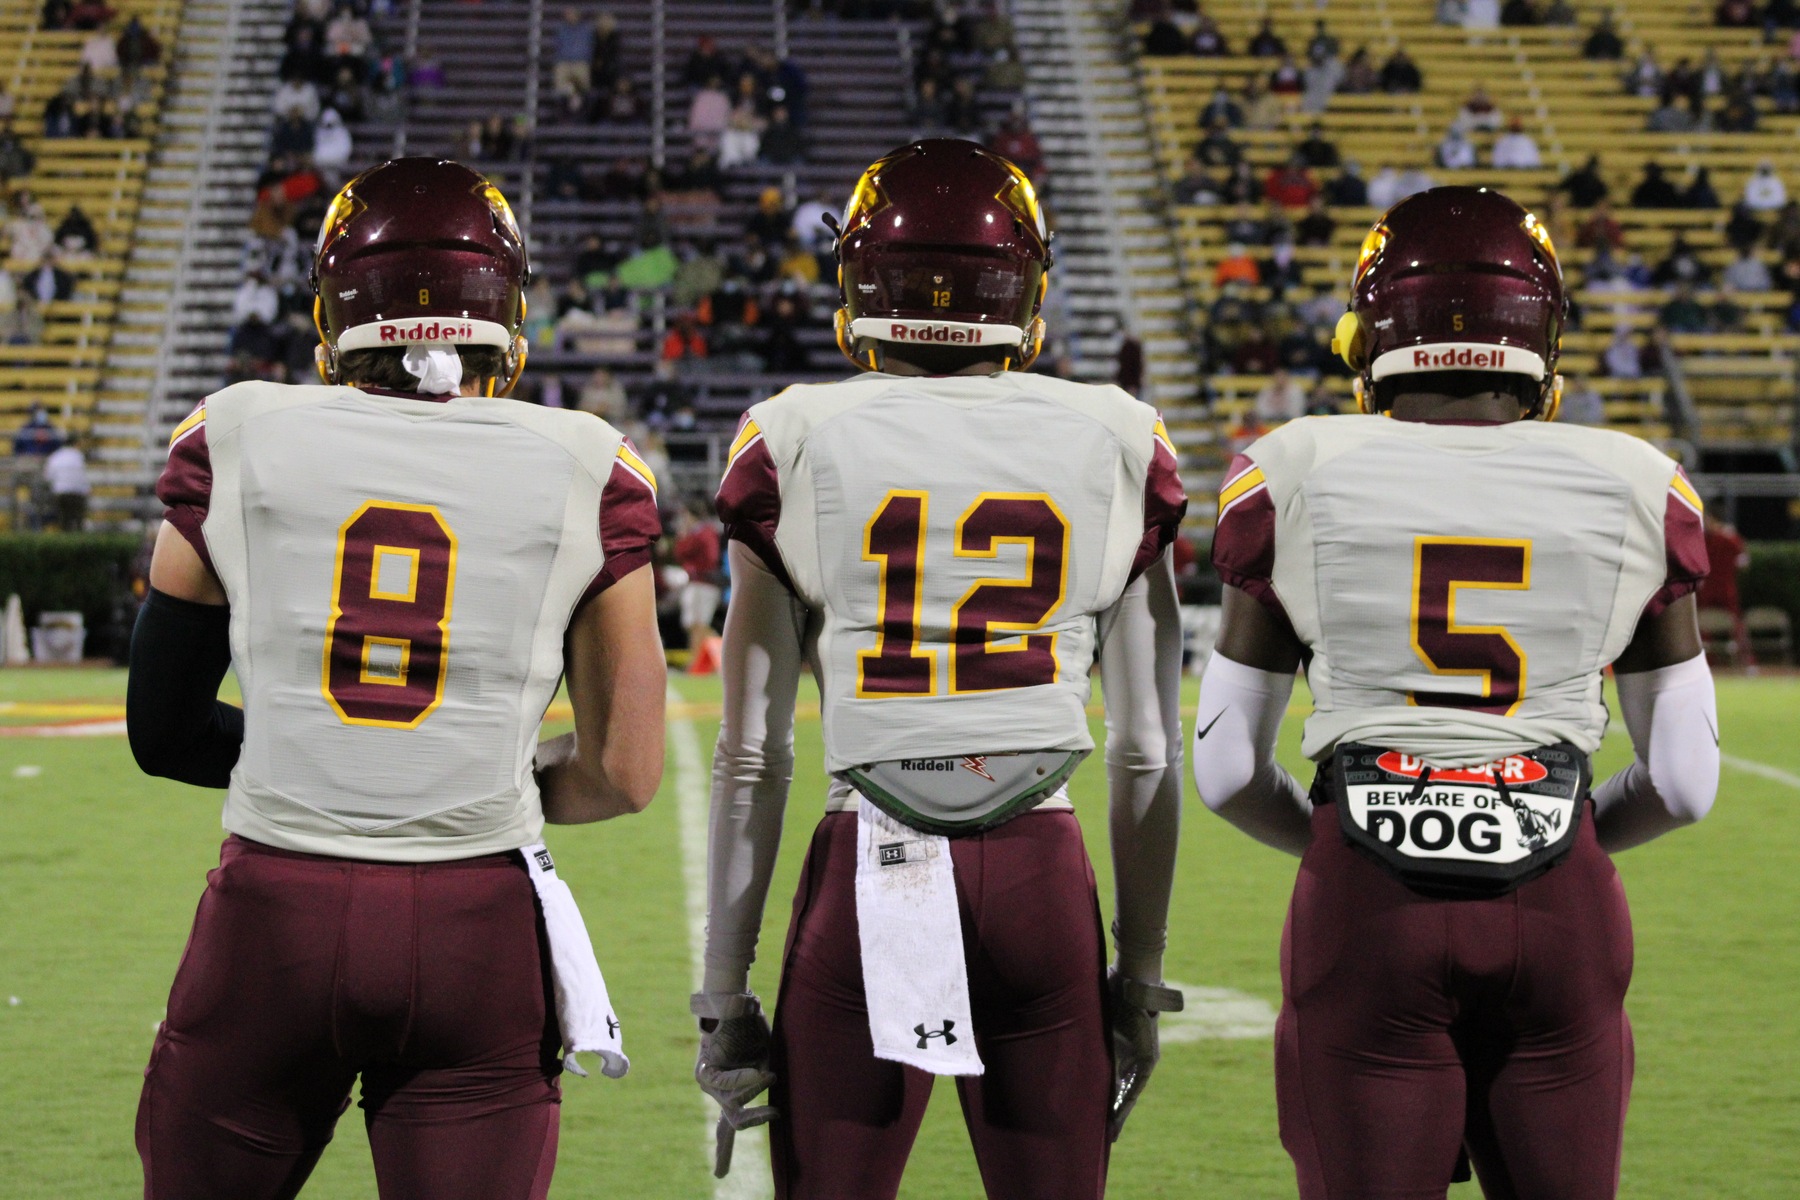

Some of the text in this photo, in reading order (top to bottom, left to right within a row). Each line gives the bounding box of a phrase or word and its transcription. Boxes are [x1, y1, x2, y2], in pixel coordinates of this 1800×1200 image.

[419, 289, 429, 305] 8
[932, 290, 950, 307] 12
[379, 322, 472, 342] Riddell
[1453, 314, 1464, 332] 5
[891, 323, 983, 344] Riddell
[1413, 348, 1505, 368] Riddell
[856, 489, 1071, 698] 12
[320, 499, 459, 730] 8
[1407, 536, 1532, 717] 5
[901, 759, 954, 771] Riddell
[1400, 753, 1525, 779] DER
[1366, 791, 1465, 807] BEWARE
[1366, 809, 1502, 854] DOG
